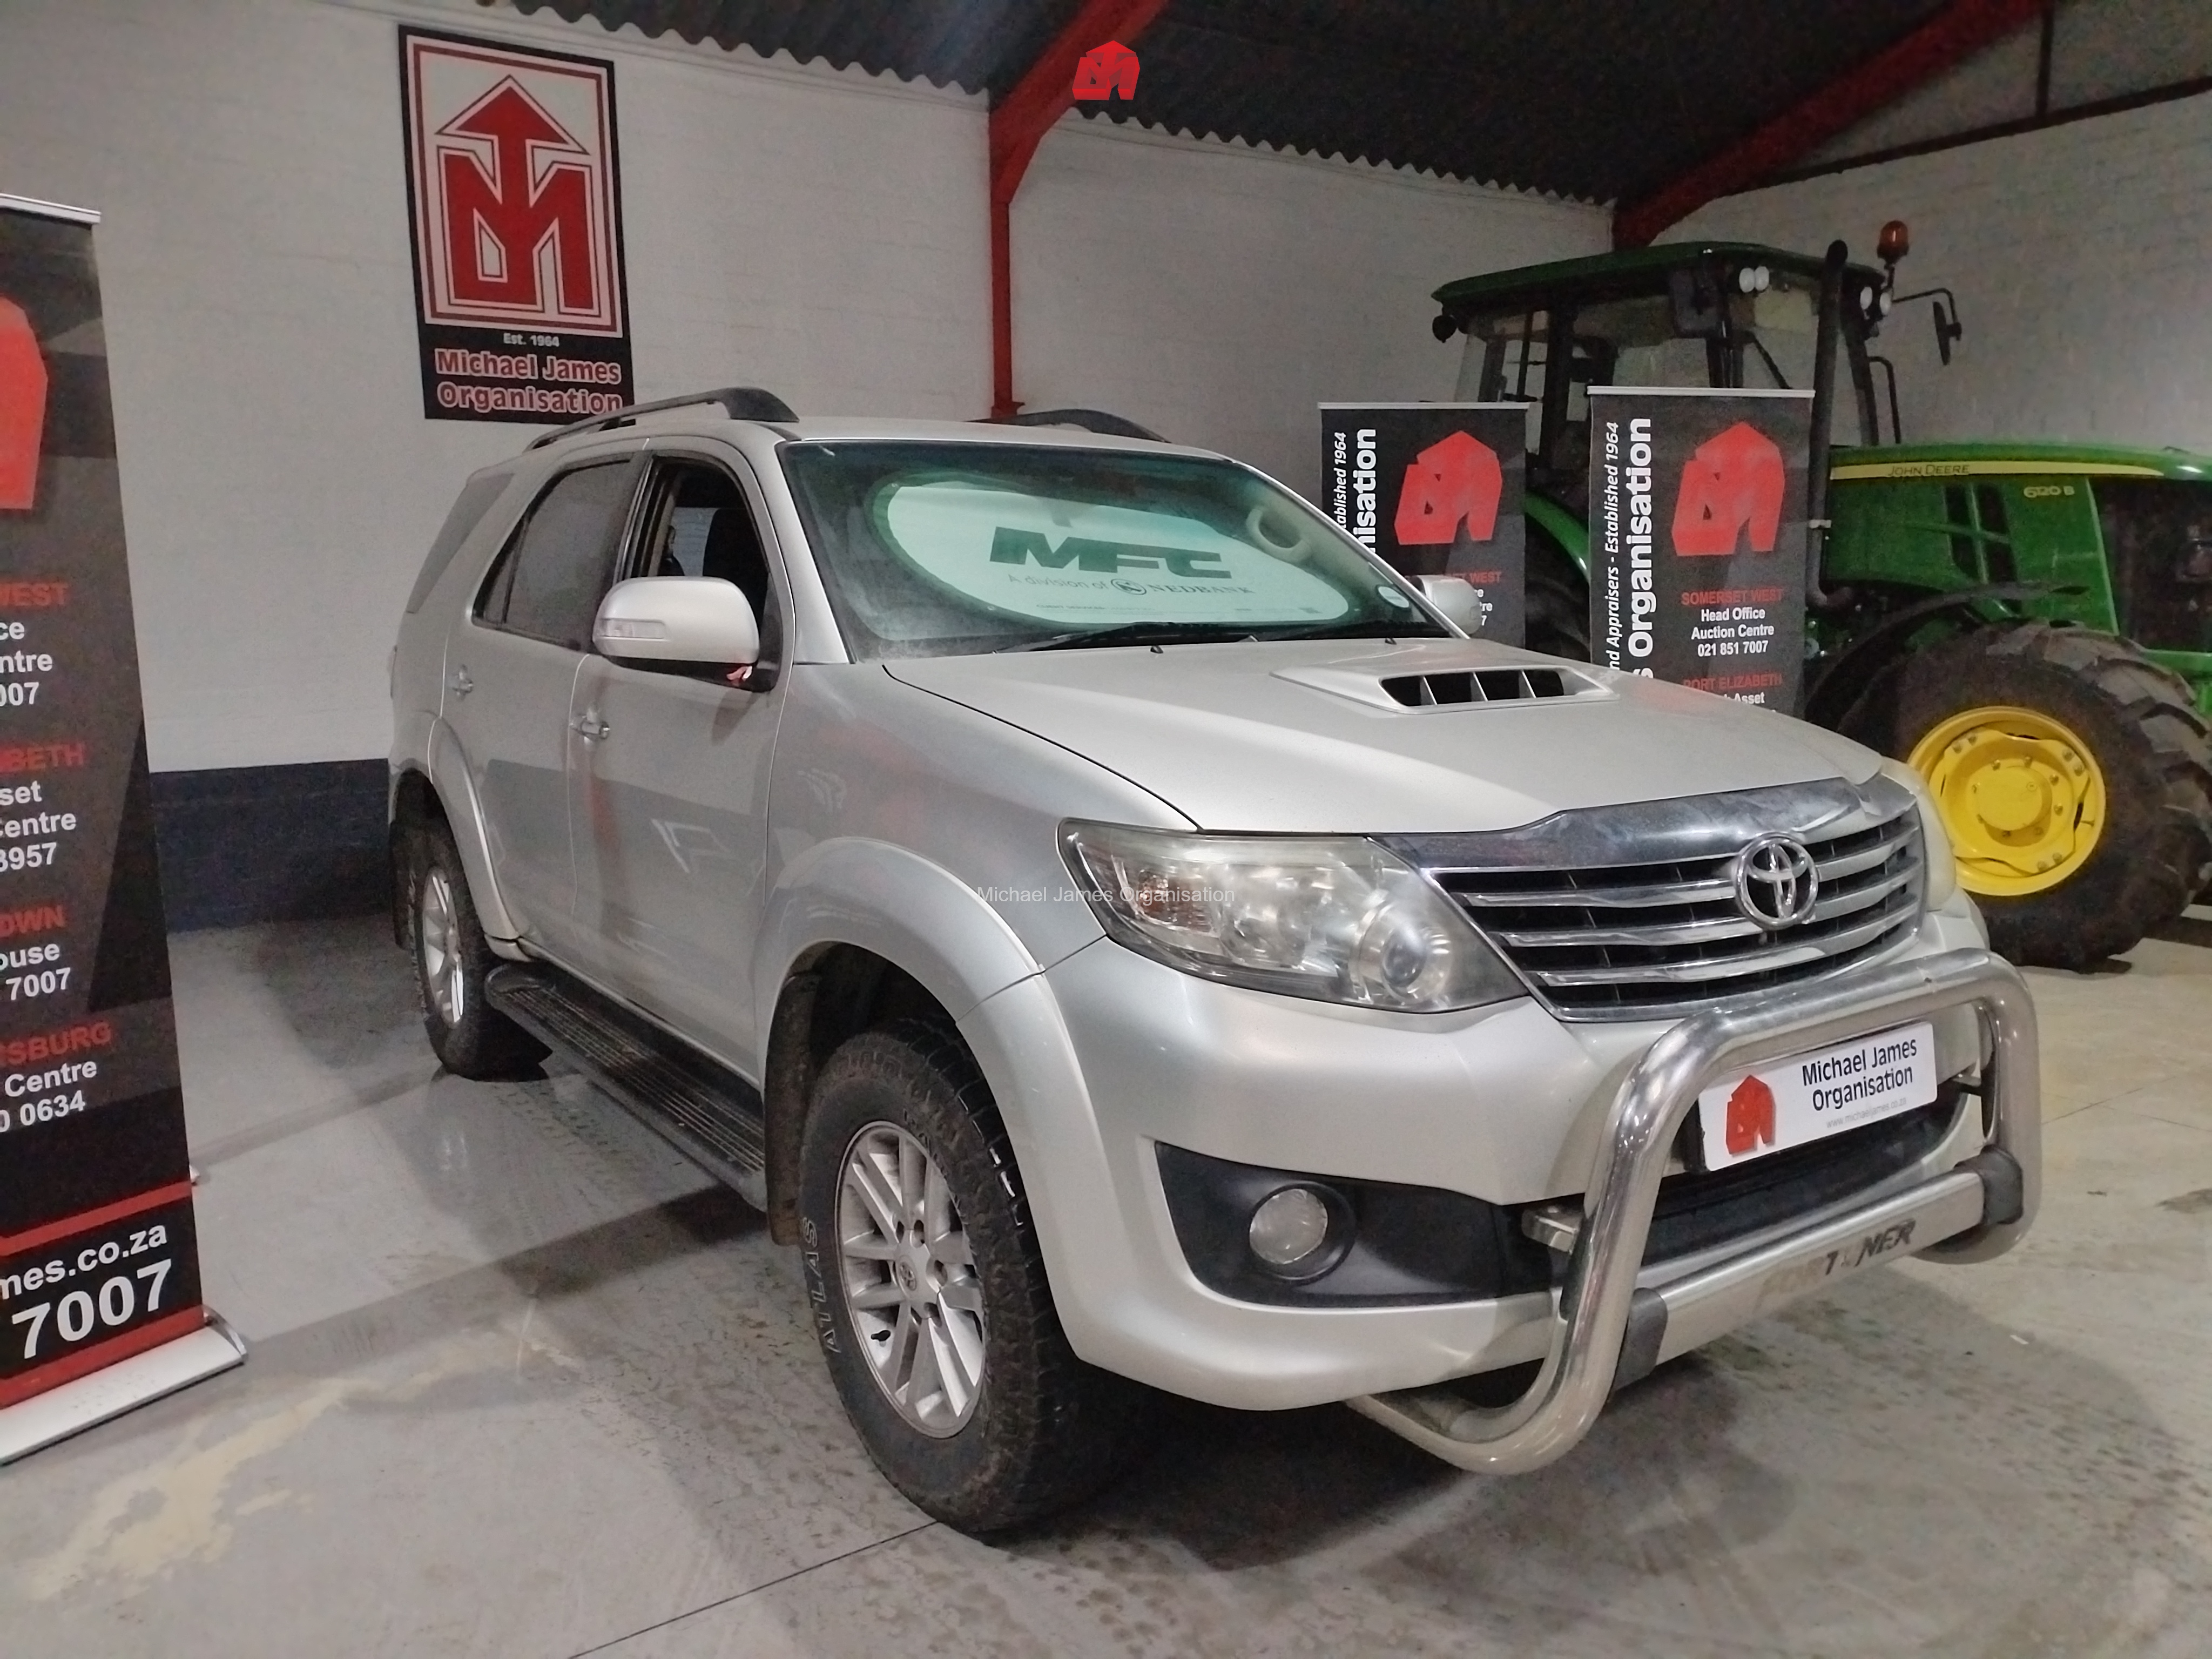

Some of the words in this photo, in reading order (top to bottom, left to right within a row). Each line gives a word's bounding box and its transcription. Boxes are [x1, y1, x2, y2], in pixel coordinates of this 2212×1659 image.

[503, 333, 527, 345] Est.
[530, 335, 560, 347] 1964
[435, 348, 538, 379] Michael
[542, 355, 622, 384] James
[437, 381, 623, 414] Organisation
[1334, 432, 1346, 465] 1964
[1606, 422, 1618, 460] 1964
[1888, 464, 1924, 477] JOHN
[1925, 464, 1970, 476] DEERE
[1604, 464, 1618, 553] Established
[990, 526, 1231, 579] MFC
[1626, 419, 1656, 657] Organisation
[1008, 574, 1022, 584] A
[1025, 575, 1090, 589] division
[1092, 580, 1110, 589] of
[1148, 584, 1256, 594] NEDBANK
[1468, 571, 1502, 584] WEST
[1604, 567, 1622, 648] Appraisers
[1681, 590, 1748, 606] SOMERSET
[1750, 588, 1784, 603] WEST
[1701, 608, 1730, 622] Head
[1732, 606, 1766, 621] Office
[1691, 626, 1735, 640] Auction
[1737, 624, 1775, 637] Centre
[1697, 643, 1716, 657] 021
[1719, 641, 1739, 656] 851
[1743, 640, 1769, 654] 7007
[1718, 674, 1782, 690] ELIZABETH
[1734, 692, 1765, 705] Asset
[0, 812, 77, 838] entre
[5, 967, 71, 1001] 7007
[1801, 1049, 1866, 1087] Michael
[1871, 1036, 1918, 1069] James
[4, 1061, 97, 1097] Centre
[1812, 1064, 1914, 1111] Organisation
[20, 1089, 86, 1131] 0634
[11, 1258, 172, 1360] 7007
